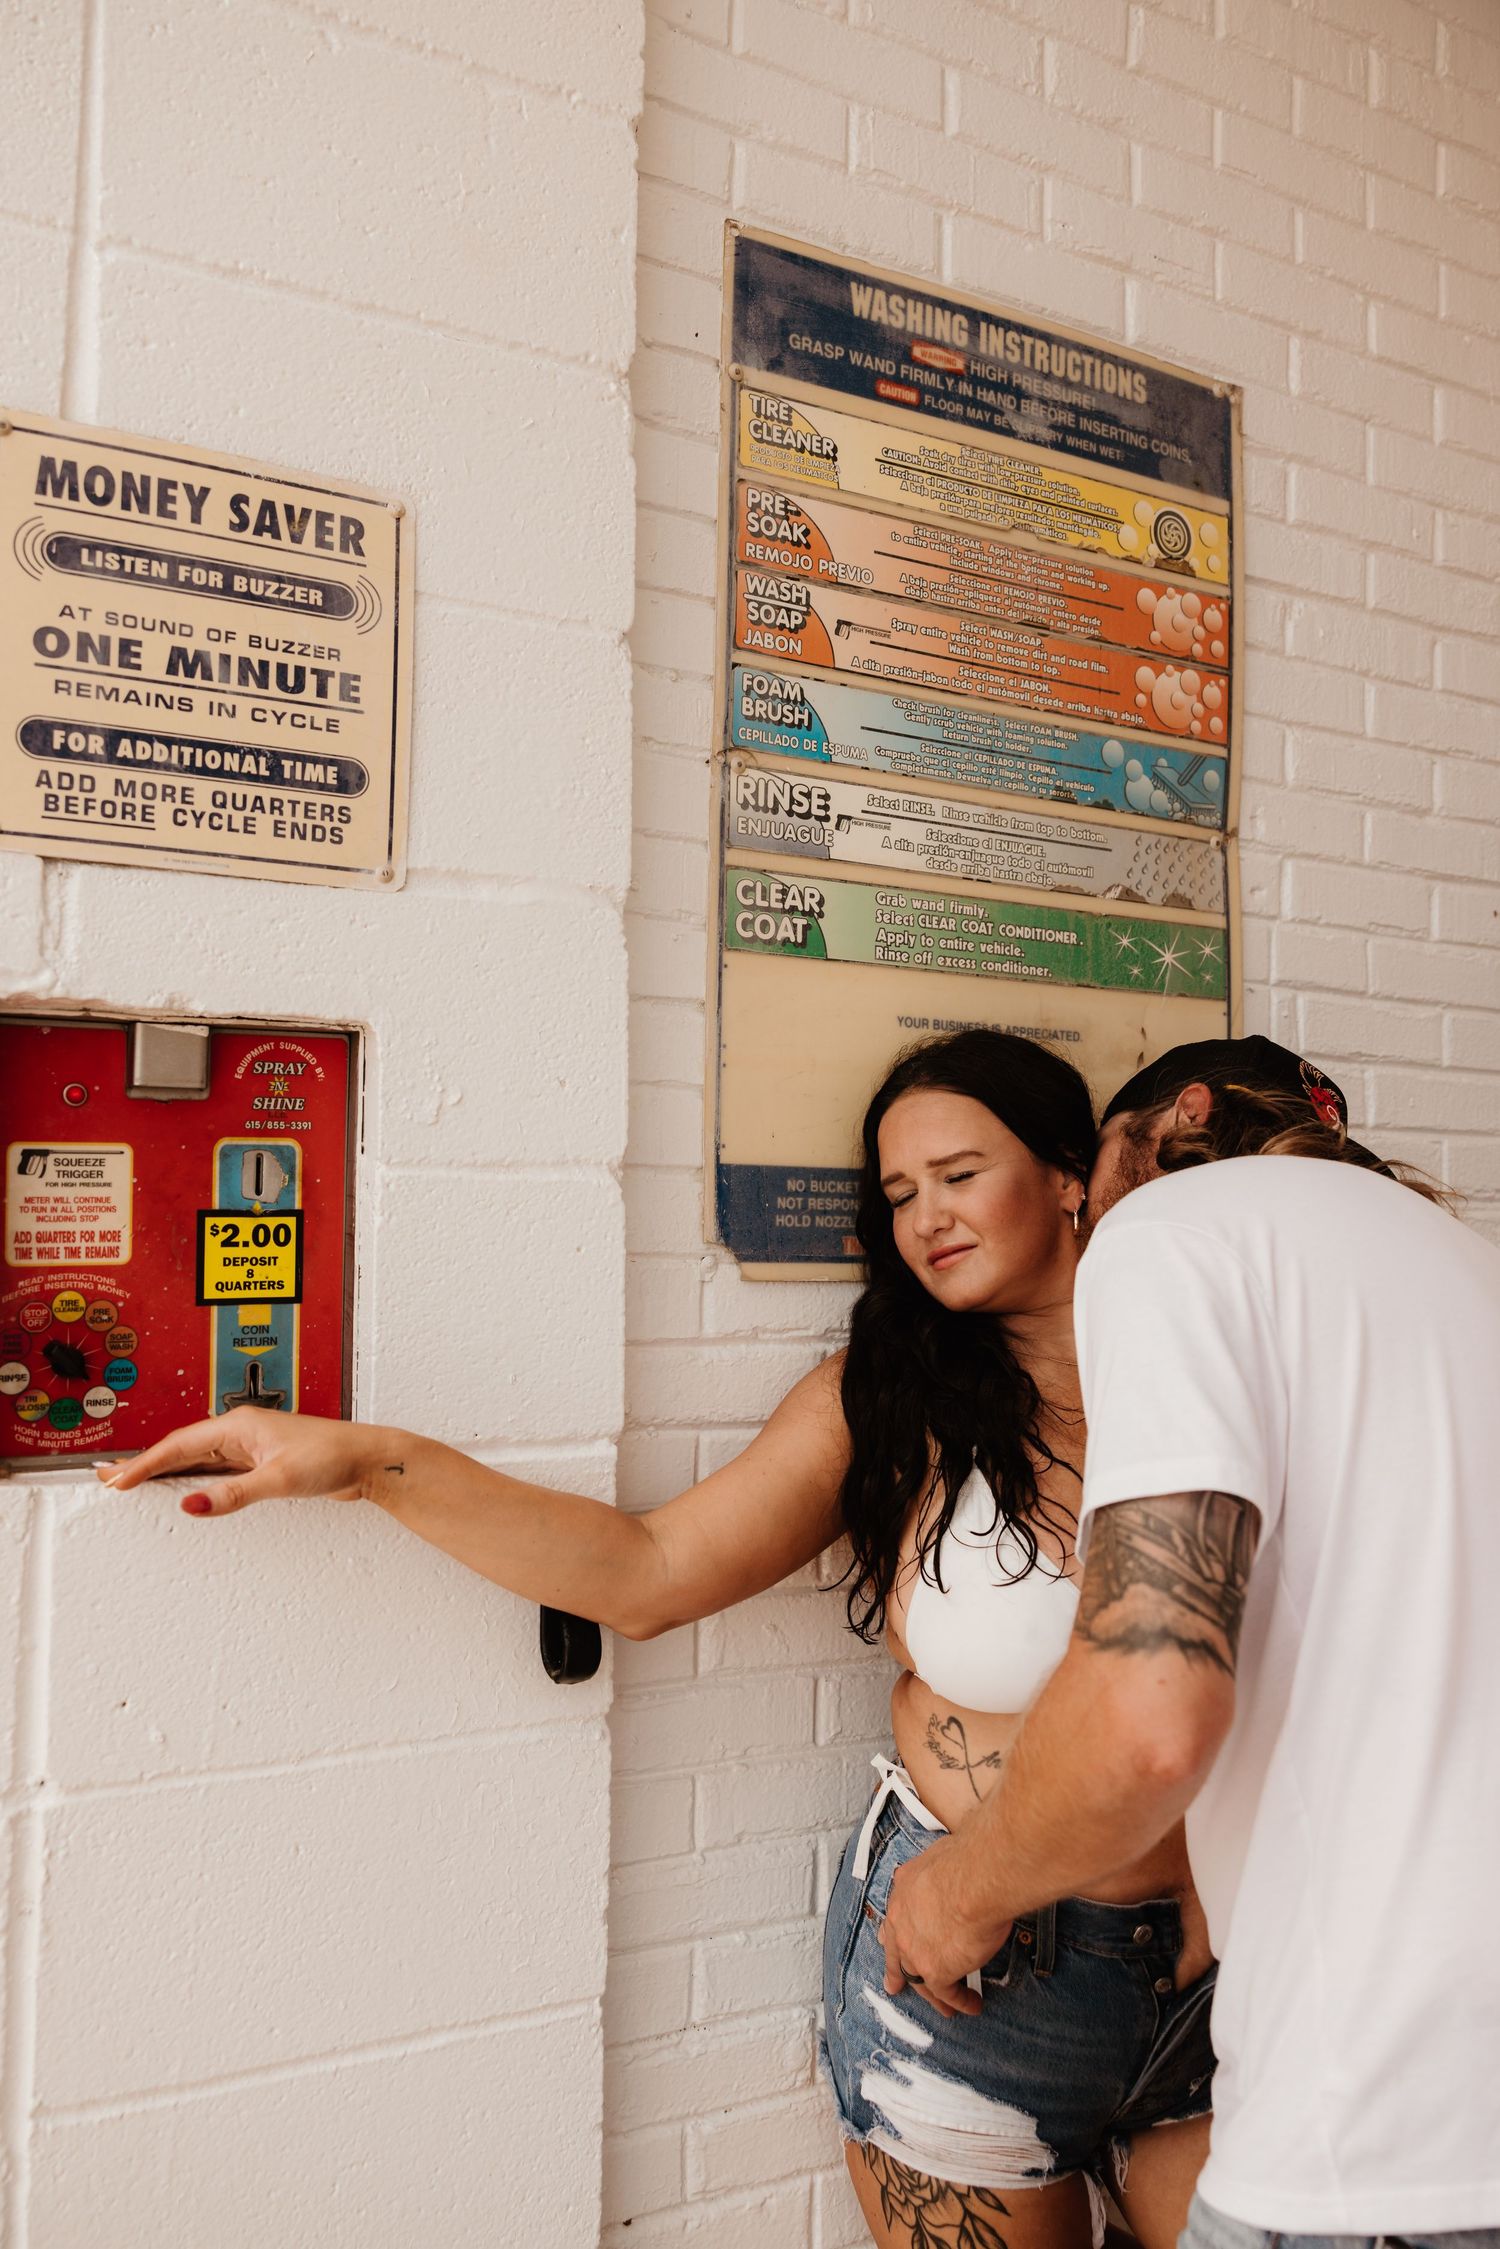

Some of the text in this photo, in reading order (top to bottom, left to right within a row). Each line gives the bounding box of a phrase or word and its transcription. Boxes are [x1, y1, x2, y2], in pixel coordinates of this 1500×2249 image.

[849, 280, 1147, 405] WASHING INSTRUCTIONS
[789, 332, 844, 362] GRASP
[849, 349, 895, 377] WAND
[900, 363, 954, 393] FIRMLY
[958, 380, 972, 398] IN
[976, 385, 1016, 411] HAND
[1020, 398, 1075, 428] BEFORE
[1079, 416, 1148, 450] INSERTING
[879, 382, 916, 402] CAUTION
[970, 359, 1095, 411] HIGH PRESSURE!
[748, 393, 790, 423] TIRE
[748, 416, 835, 459] CLEANER
[924, 394, 963, 415] FLOOR
[966, 405, 989, 423] MAY
[993, 414, 1008, 428] BE
[1066, 434, 1096, 453] WHEN
[34, 453, 367, 558] MONEY SAVER
[746, 486, 798, 519] PRE-
[746, 510, 807, 545] SOAK
[80, 547, 323, 606] LISTEN FOR BUZZER
[744, 541, 874, 585] REMOJO PREVIO
[744, 572, 808, 606] WASH
[747, 600, 804, 631] SOAP
[58, 603, 341, 662] AT SOUND OF BUZZER
[742, 627, 802, 656] JABON
[891, 617, 1109, 674] Spray entire vehicle to remove dirt and road film.
[959, 620, 1043, 648] Select WASH/SOAP.
[32, 623, 362, 704] ONE MINUTE
[741, 671, 803, 702] FOAM
[53, 678, 340, 734] REMAINS IN CYCLE
[740, 695, 809, 728] BRUSH
[52, 729, 338, 784] FOR ADDITIONAL TIME
[738, 726, 869, 761] CEPILLADO DE ESPUMA
[35, 769, 352, 824] ADD MORE QUARTERS
[735, 773, 828, 818] RINSE
[43, 792, 344, 845] BEFORE CYCLE ENDS
[736, 815, 835, 848] ENJUAGUE
[866, 793, 1107, 843] Select RINSE. Rinse vehicle from top to bottom.
[735, 877, 821, 914] CLEAR
[875, 890, 989, 920] Grab wand firmly.
[734, 909, 808, 944] COAT
[875, 908, 914, 927] Select
[917, 913, 956, 932] CLEAR
[961, 918, 993, 936] COAT
[875, 927, 1025, 957] Apply to entire vehicle.
[874, 946, 1052, 978] Rinse off excess conditioner.
[897, 1015, 929, 1030] YOUR
[933, 1018, 986, 1034] BUSINESS
[234, 1042, 275, 1079] EQUIPMENT
[280, 1042, 317, 1065] SUPPLIED
[253, 1061, 307, 1075] SPRAY
[253, 1098, 304, 1110] SHINE
[245, 1121, 311, 1130] 615/855-3391
[53, 1158, 106, 1167] SQUEEZE
[56, 1170, 103, 1178] TRIGGER
[74, 1196, 111, 1204] CONTINUE
[787, 1180, 805, 1192] NO
[777, 1197, 803, 1209] NOT
[210, 1223, 291, 1248] $2.00
[776, 1215, 811, 1227] HOLD
[14, 1230, 121, 1244] ADD QUARTERS FOR MORE
[14, 1246, 120, 1260] TIME WHILE TIME REMAINS
[223, 1257, 278, 1267] DEPOSIT
[18, 1273, 116, 1288] READ INSTRUCTIONS
[215, 1280, 284, 1292] QUARTERS
[246, 1269, 254, 1278] 8
[2, 1282, 131, 1303] BEFORE INSERTING MONEY
[59, 1299, 79, 1307] TIRE
[24, 1309, 48, 1317] STOP
[27, 1319, 44, 1327] OFF
[233, 1337, 278, 1347] RETURN
[241, 1325, 269, 1335] COIN
[86, 1399, 114, 1407] RINSE
[14, 1420, 111, 1439] HORN SOUNDS WHEN
[15, 1427, 113, 1448] ONE MINUTE REMAINS
